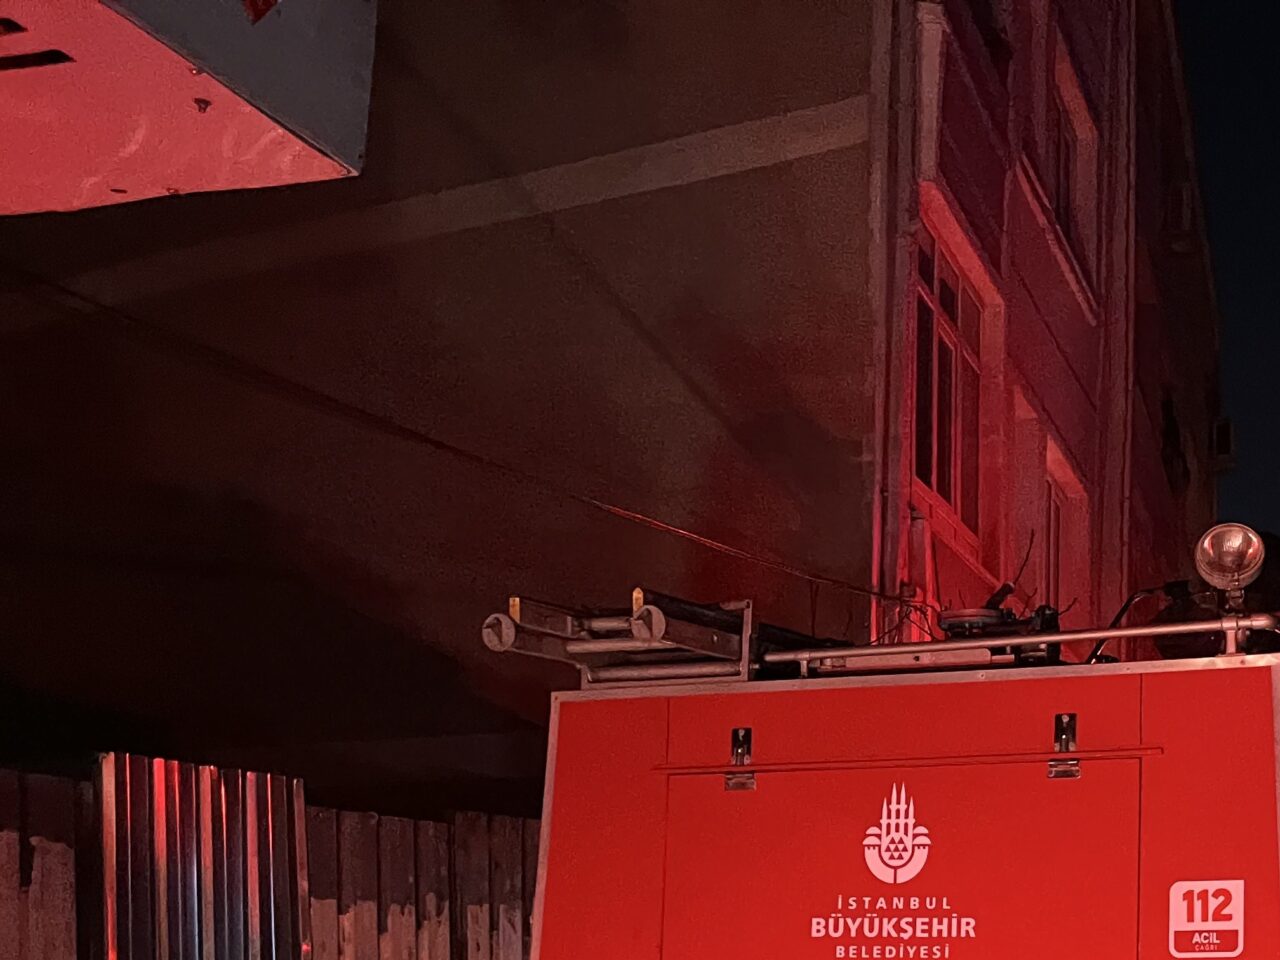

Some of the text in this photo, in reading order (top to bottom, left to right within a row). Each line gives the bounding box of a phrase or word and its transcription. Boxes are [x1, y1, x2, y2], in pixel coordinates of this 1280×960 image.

[837, 895, 951, 910] İSTANBUL
[1183, 888, 1233, 923] 112
[811, 913, 976, 940] BÜYÜKŞEHİR
[1192, 932, 1221, 944] ACİL
[835, 943, 950, 959] BELEDİYESİ
